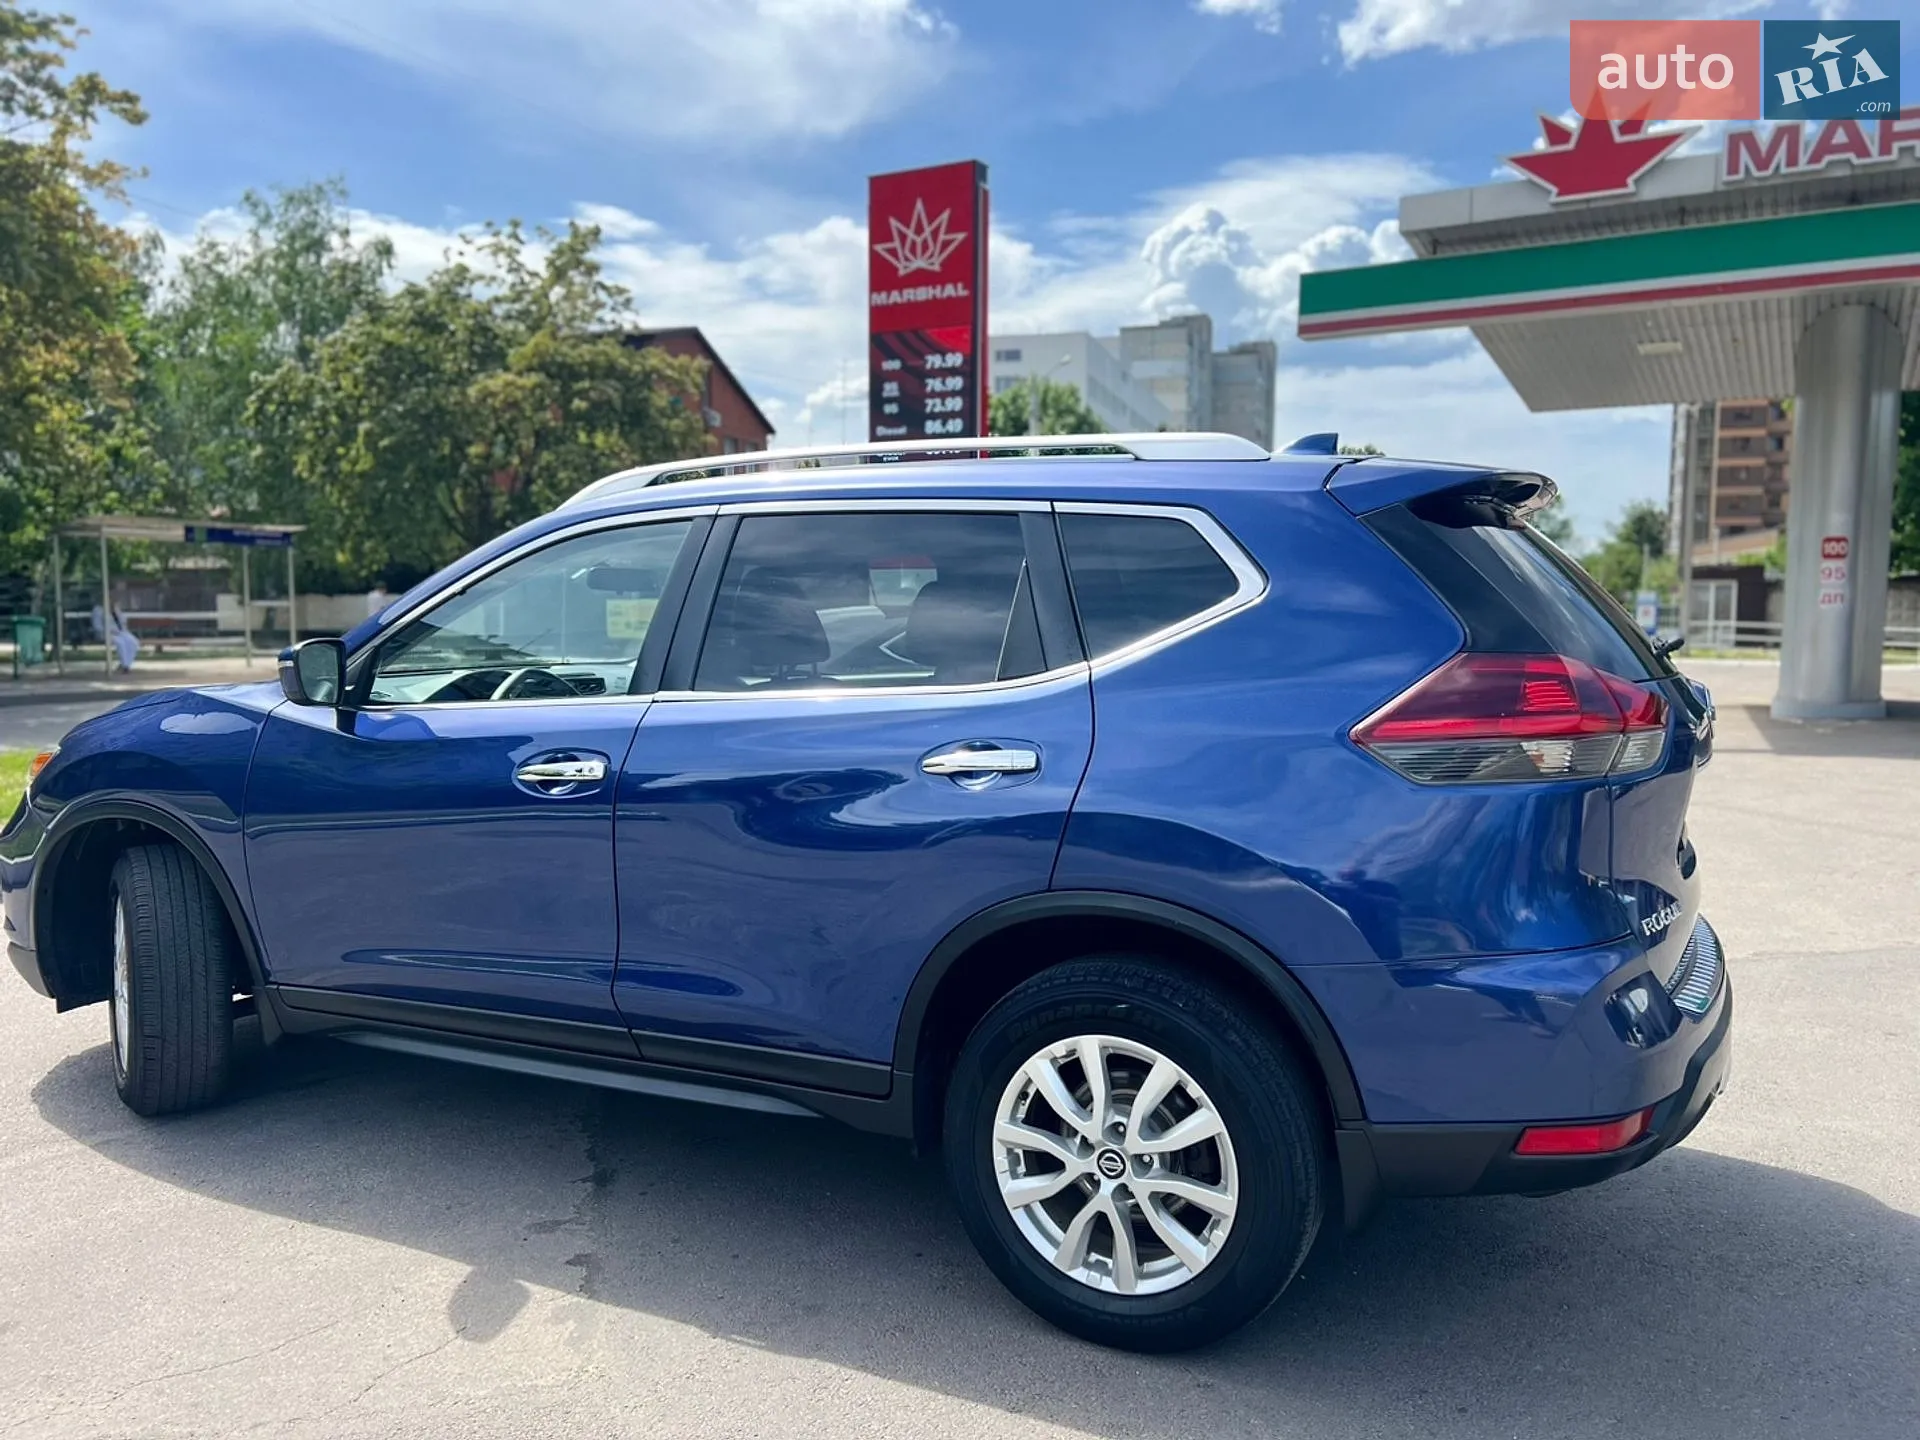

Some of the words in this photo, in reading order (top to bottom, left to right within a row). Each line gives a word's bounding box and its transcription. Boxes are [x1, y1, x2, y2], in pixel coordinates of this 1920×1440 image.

[871, 282, 969, 306] MARSHAL
[924, 352, 963, 369] 79.99
[925, 376, 964, 393] 76.99
[924, 396, 963, 414] 73.99
[1823, 541, 1847, 556] 100
[1821, 567, 1846, 580] 95
